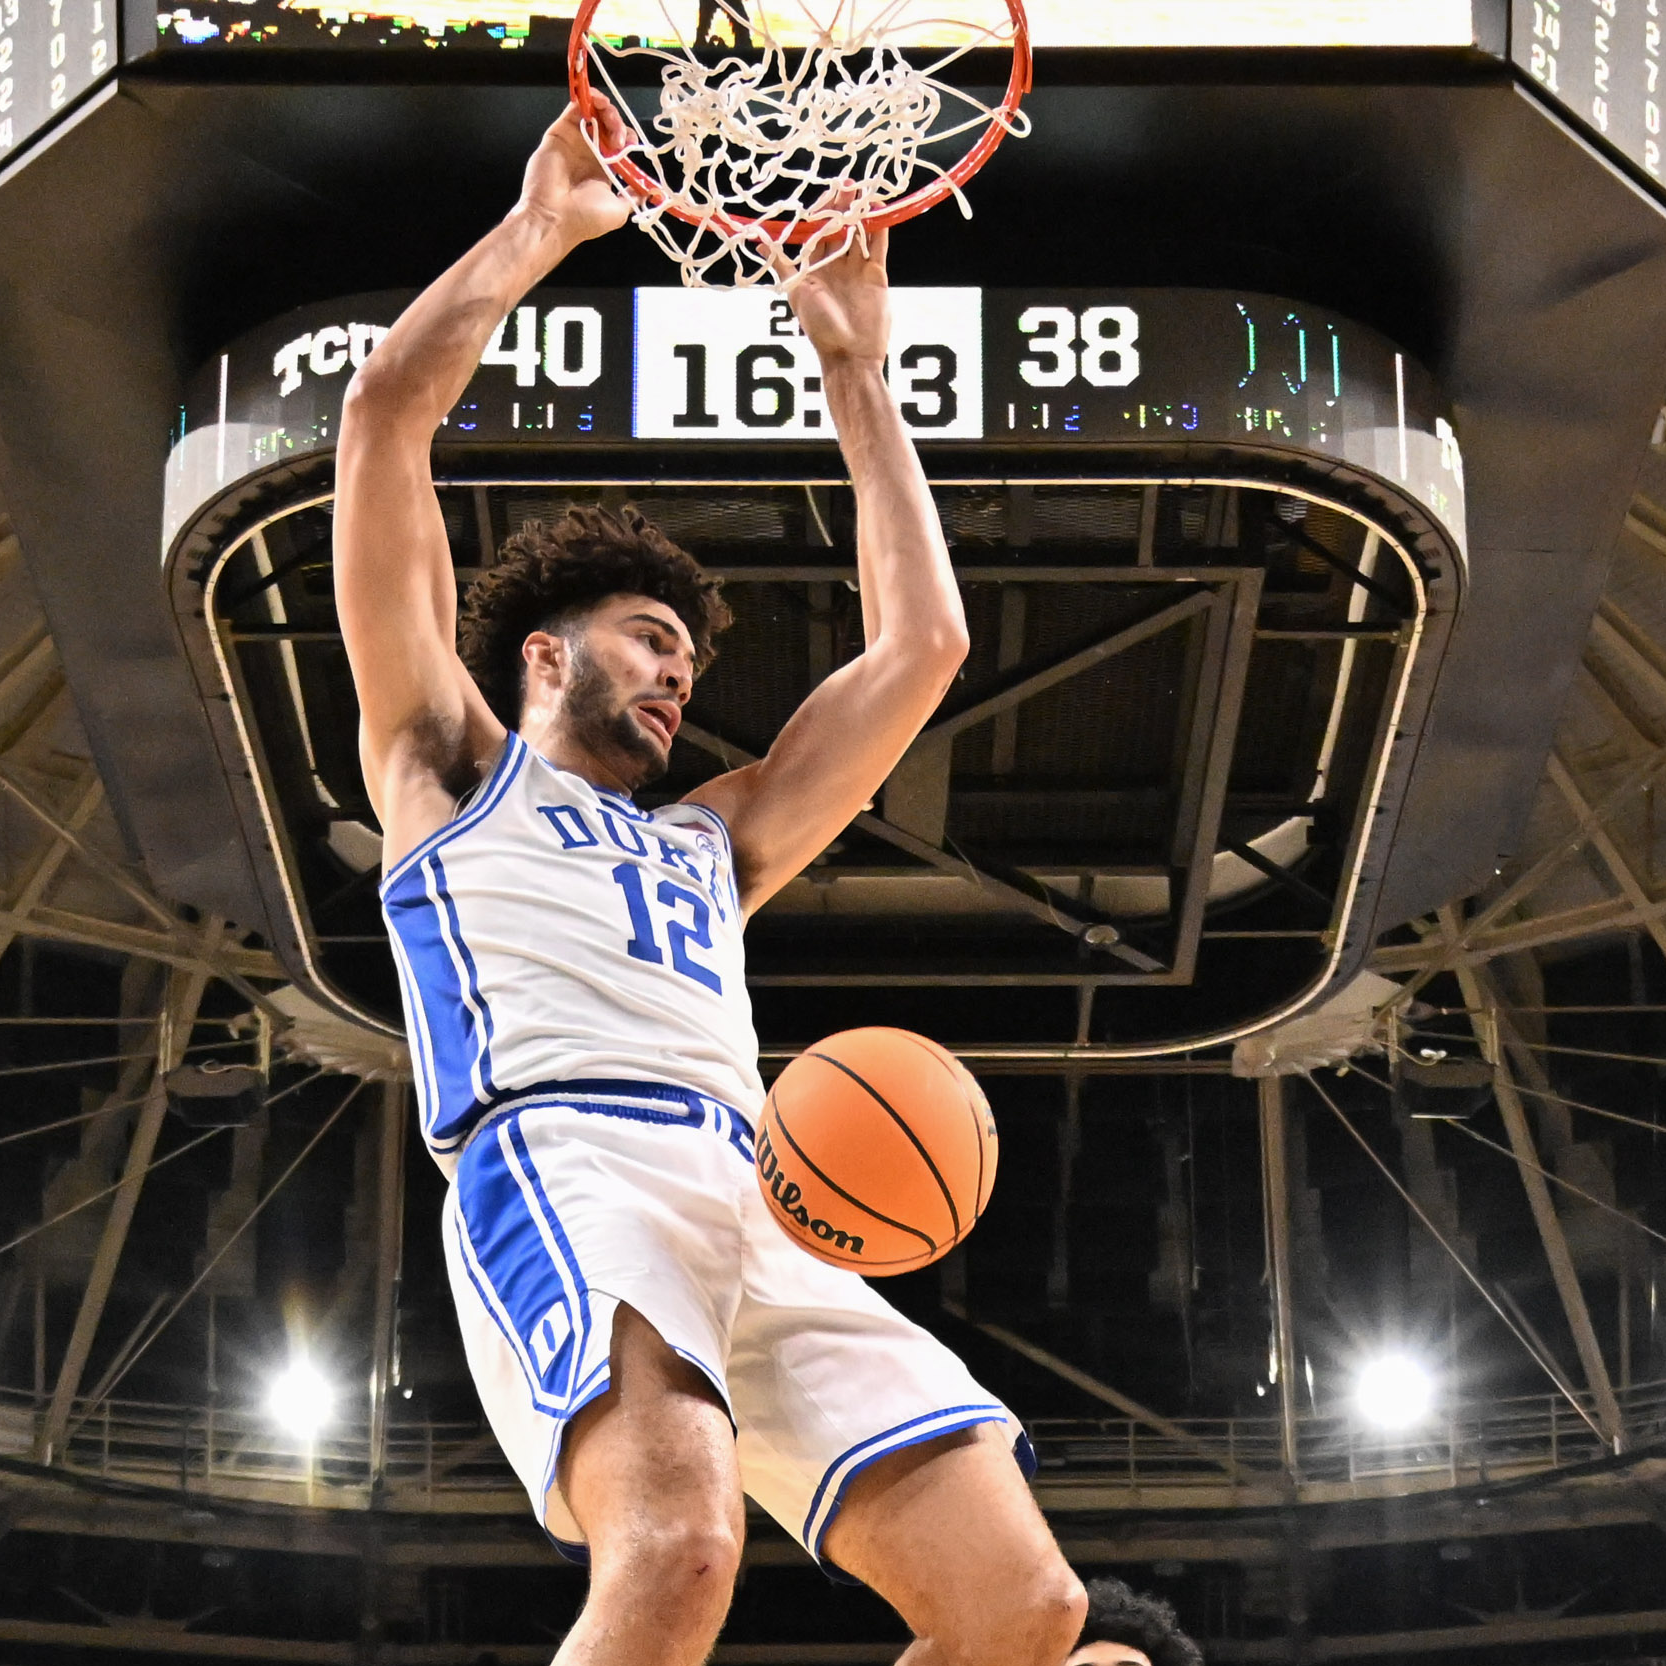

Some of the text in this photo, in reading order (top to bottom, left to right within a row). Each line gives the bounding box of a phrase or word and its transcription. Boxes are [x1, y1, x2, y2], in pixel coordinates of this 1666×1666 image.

[50, 33, 65, 69] 0
[93, 0, 104, 34] 1
[50, 74, 66, 109] 2
[91, 40, 107, 76] 2
[1533, 2, 1560, 51] 14
[1595, 56, 1609, 92] 2
[1646, 100, 1660, 134] 0
[1595, 16, 1609, 53] 2
[1645, 58, 1658, 93] 7
[1646, 21, 1660, 56] 2
[1531, 44, 1559, 93] 21
[1593, 96, 1607, 132] 4
[1646, 139, 1659, 175] 2
[481, 306, 602, 387] 40
[673, 344, 957, 428] 16:3
[1019, 306, 1140, 387] 38
[536, 804, 727, 924] DUKE
[612, 861, 723, 997] 12
[756, 1120, 865, 1255] Wilson
